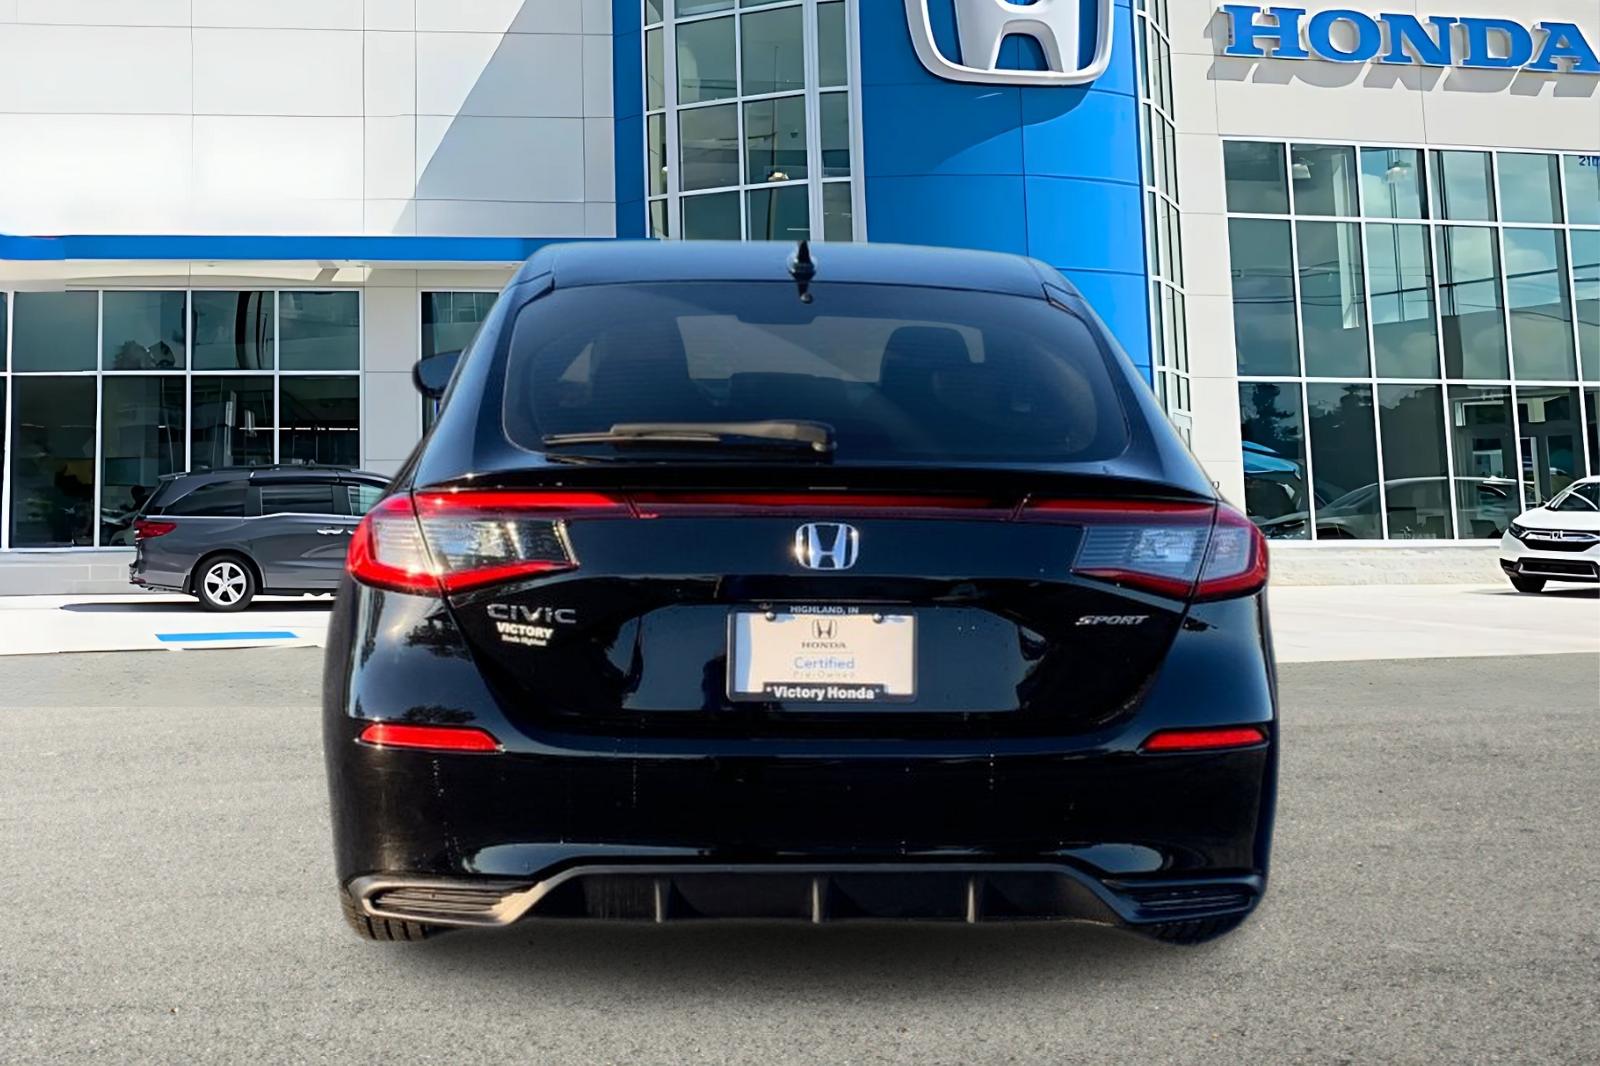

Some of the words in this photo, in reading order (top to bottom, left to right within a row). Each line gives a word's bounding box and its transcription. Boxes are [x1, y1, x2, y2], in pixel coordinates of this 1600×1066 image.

[1222, 4, 1600, 73] HONDA
[486, 603, 577, 624] CIVIC
[789, 605, 845, 615] HIGHLAND,
[847, 606, 859, 614] IN
[1075, 614, 1150, 626] SPORT
[496, 621, 555, 640] VICTORY
[801, 641, 846, 649] HONDA
[793, 656, 855, 670] Certified
[773, 685, 825, 701] Victory
[826, 687, 875, 700] Honda
